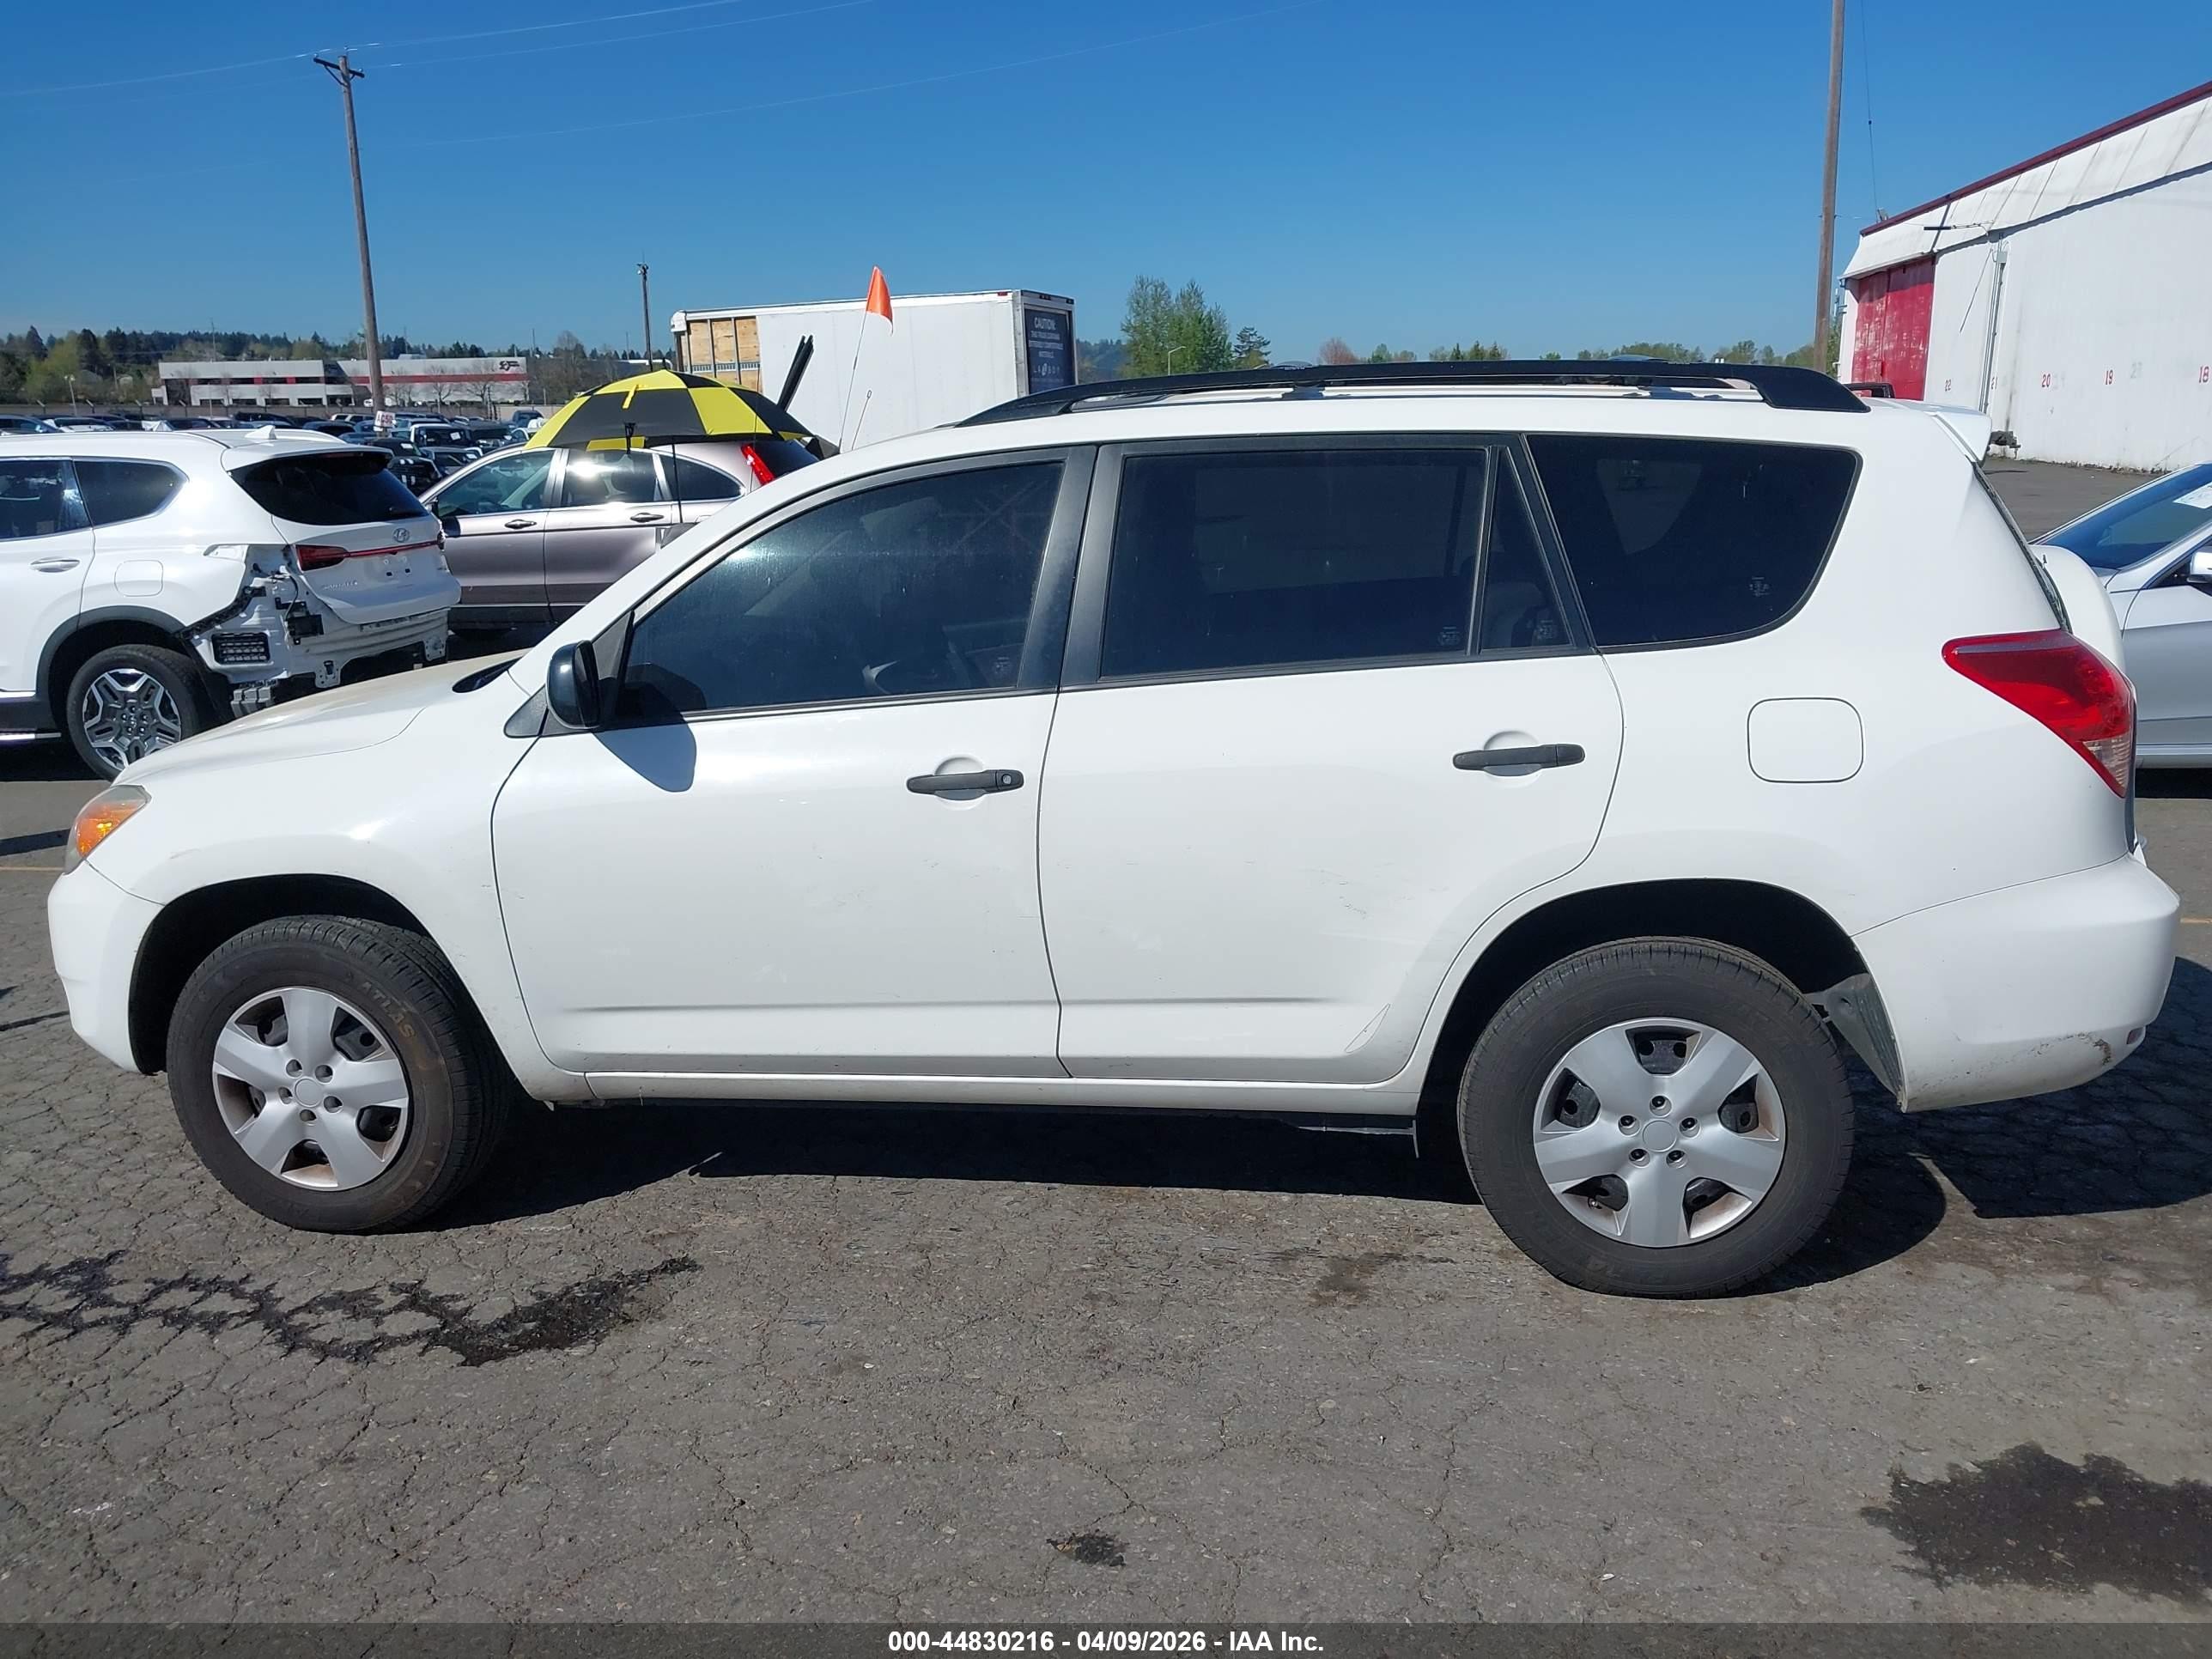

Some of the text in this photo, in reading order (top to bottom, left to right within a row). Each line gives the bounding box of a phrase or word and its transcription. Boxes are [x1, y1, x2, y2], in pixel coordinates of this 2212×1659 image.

[2041, 373, 2051, 388] 20
[2105, 369, 2114, 386] 19
[2198, 366, 2209, 383] 18
[1944, 378, 1952, 392] 22
[362, 981, 416, 1037] ATLAS
